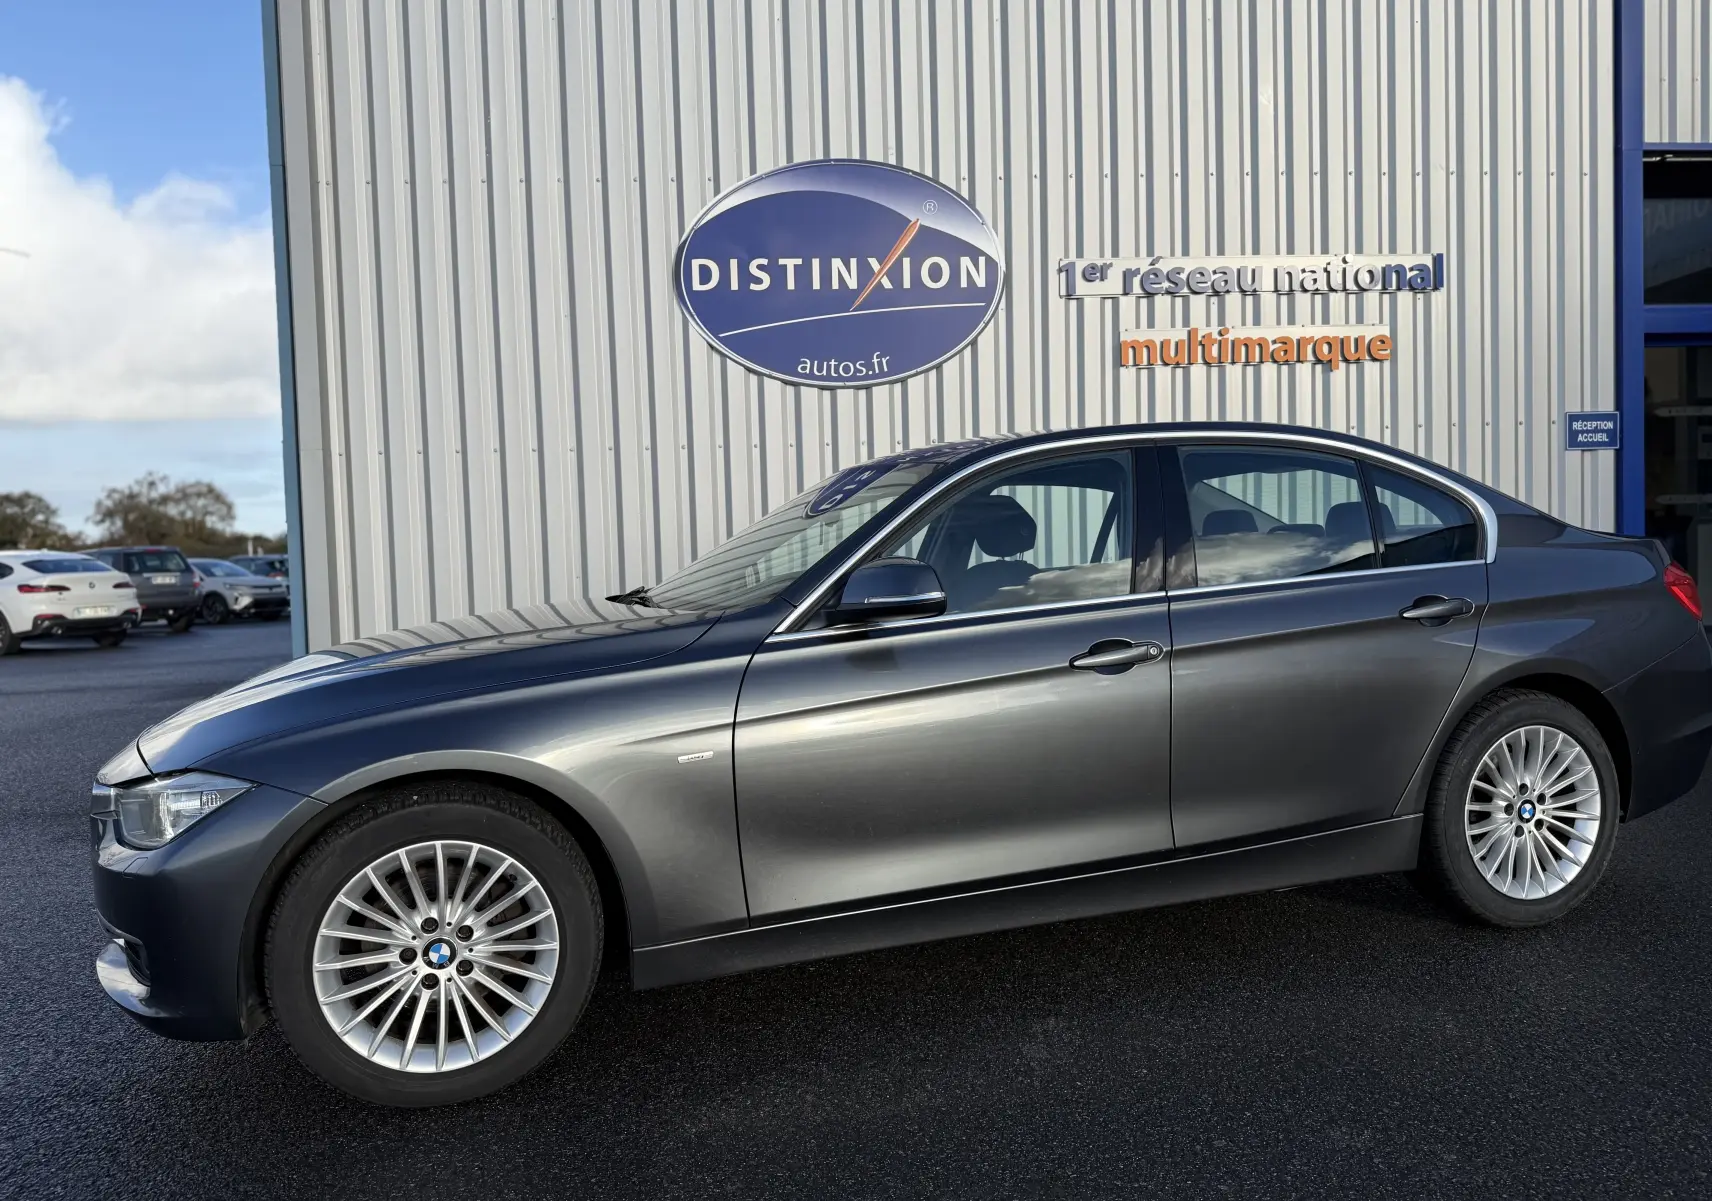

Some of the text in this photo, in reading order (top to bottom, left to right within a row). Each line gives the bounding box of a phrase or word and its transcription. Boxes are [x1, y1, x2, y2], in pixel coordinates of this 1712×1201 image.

[691, 256, 986, 291] DISTINXION
[1059, 253, 1444, 295] 1er réseau national
[1120, 327, 1393, 370] multimarque
[797, 352, 891, 377] autos.fr
[1572, 419, 1614, 430] RÉCEPTION
[1577, 432, 1609, 442] ACCUEIL
